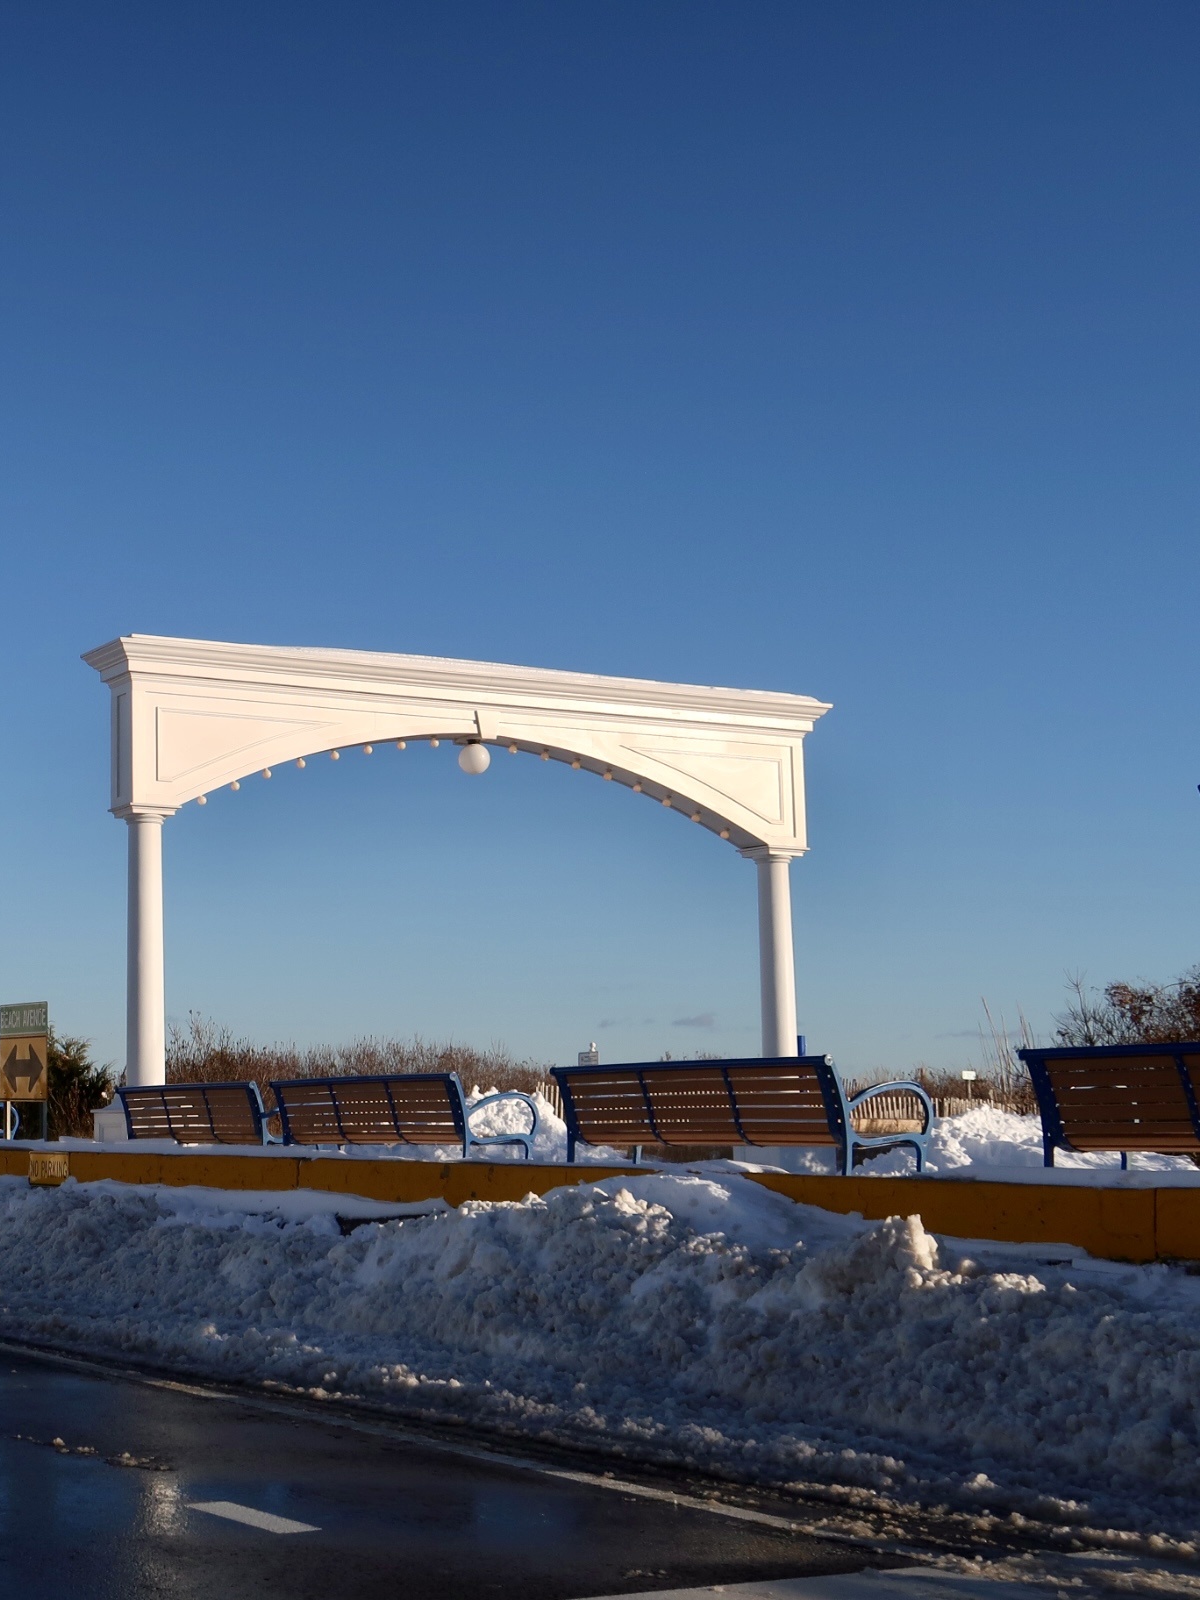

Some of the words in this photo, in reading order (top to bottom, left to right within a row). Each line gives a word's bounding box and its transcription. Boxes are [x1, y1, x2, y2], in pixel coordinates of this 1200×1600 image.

[0, 1010, 21, 1029] BEACH
[22, 1008, 46, 1027] AVENUE
[30, 1160, 39, 1178] NO
[41, 1160, 68, 1179] PARKING
